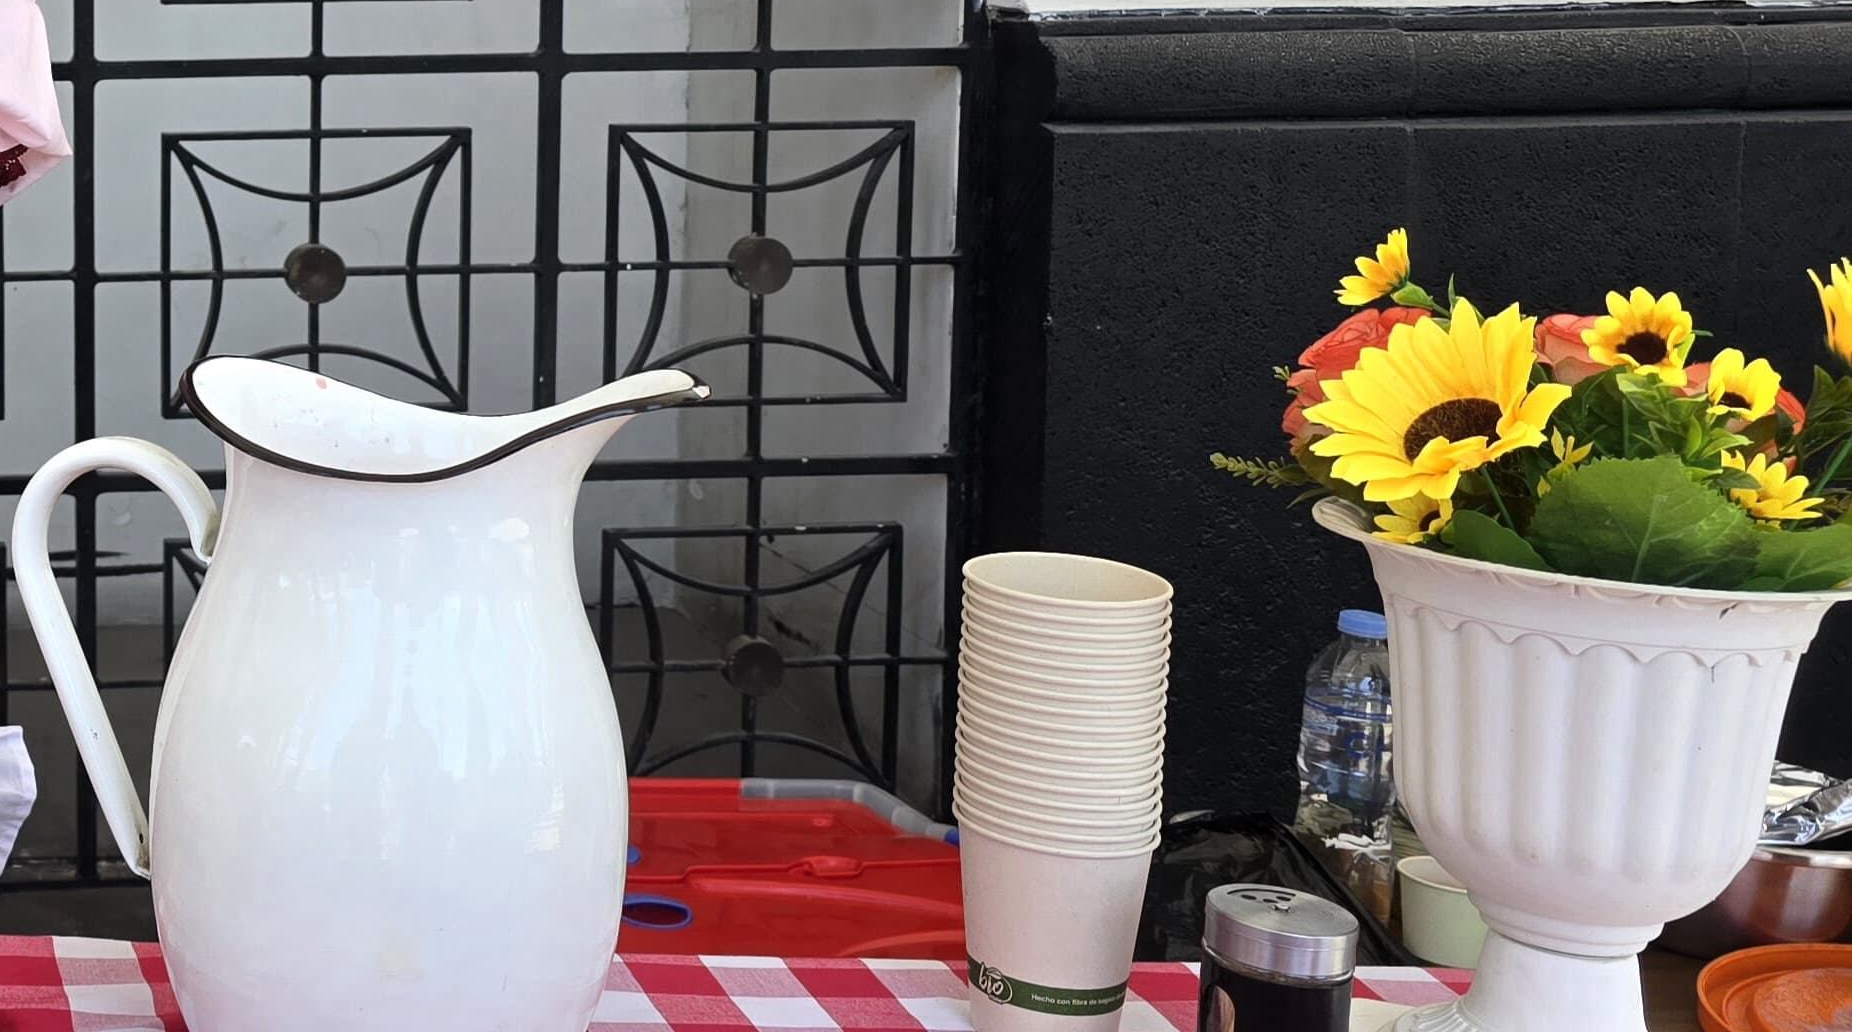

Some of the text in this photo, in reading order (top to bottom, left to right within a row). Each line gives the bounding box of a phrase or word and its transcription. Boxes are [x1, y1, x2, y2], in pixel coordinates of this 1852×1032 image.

[978, 961, 1004, 995] bio
[1031, 994, 1055, 1005] Hecho
[1056, 998, 1071, 1006] con
